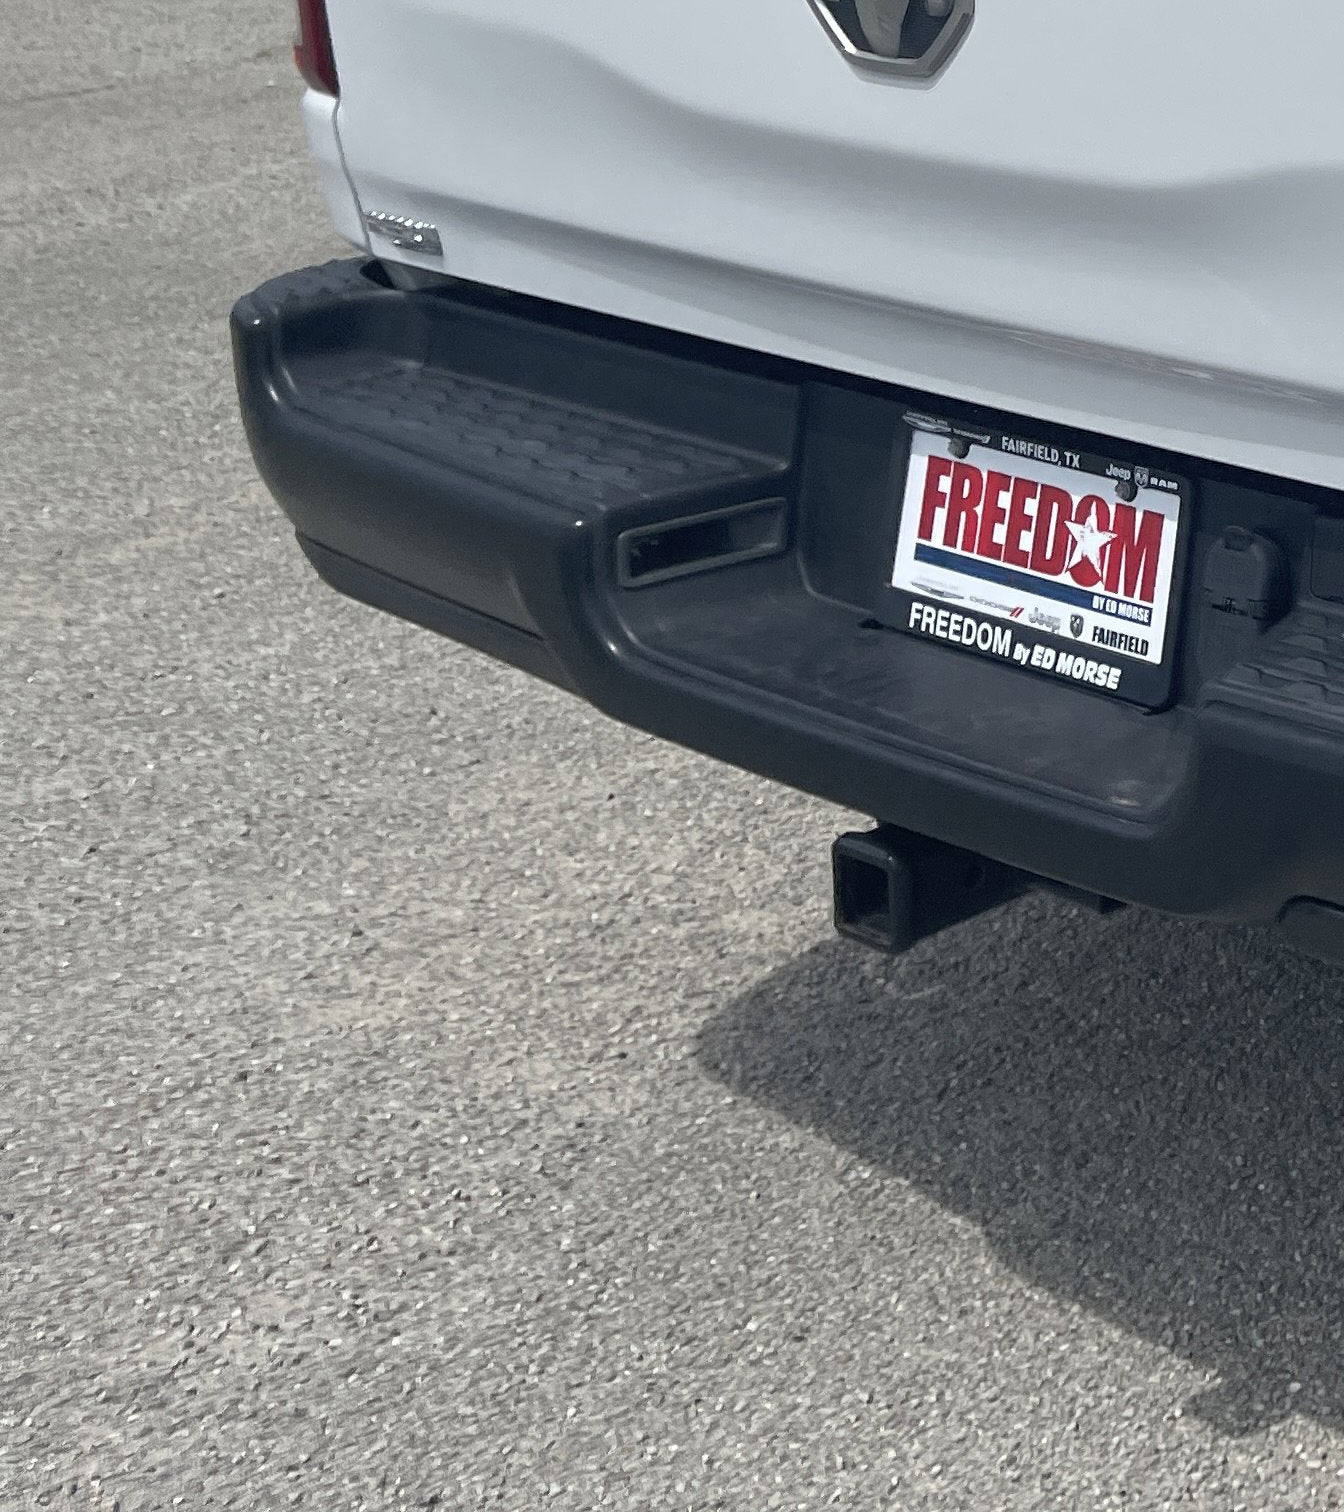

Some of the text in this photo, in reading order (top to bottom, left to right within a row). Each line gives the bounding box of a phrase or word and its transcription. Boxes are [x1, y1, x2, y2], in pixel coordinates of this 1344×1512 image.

[1001, 435, 1062, 467] FAIRFIELD,
[1063, 450, 1081, 468] TX
[1105, 463, 1131, 481] Jeep
[917, 454, 1166, 604] FREEDOM
[1092, 594, 1151, 624] BY ED MORSE
[908, 601, 1013, 658] FREEDOM
[1030, 643, 1056, 671] ED
[1055, 651, 1122, 691] MORSE
[1091, 625, 1150, 657] FAIRFIELD
